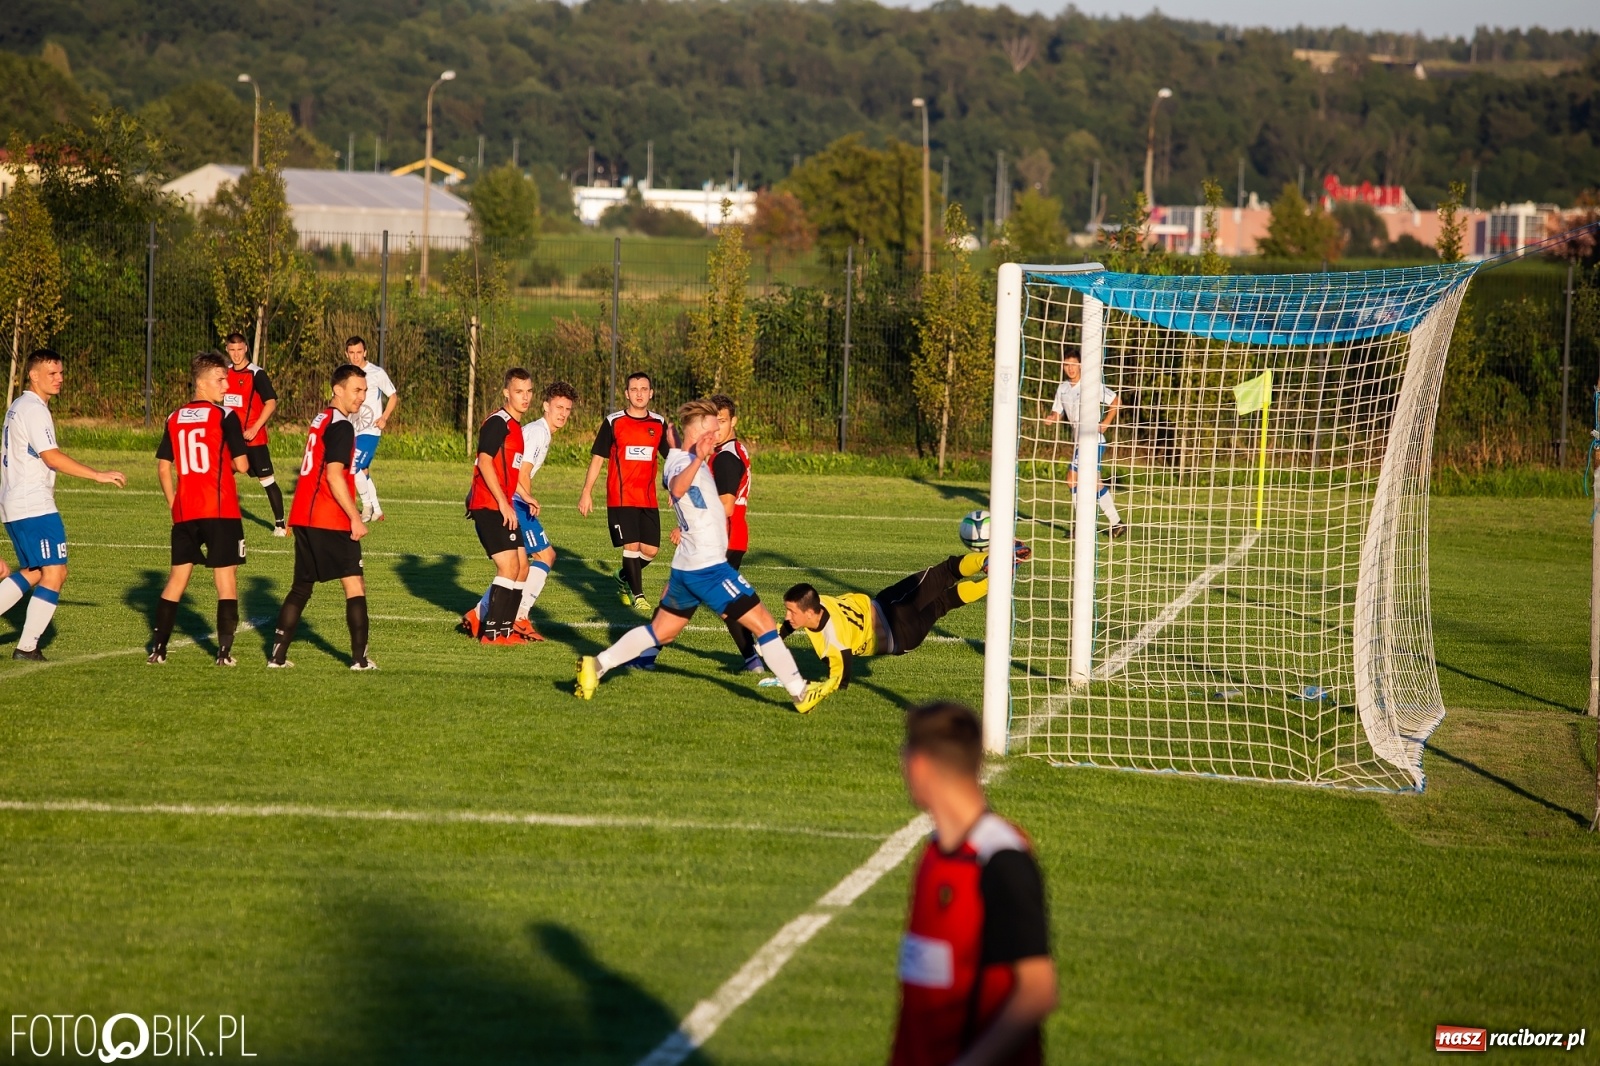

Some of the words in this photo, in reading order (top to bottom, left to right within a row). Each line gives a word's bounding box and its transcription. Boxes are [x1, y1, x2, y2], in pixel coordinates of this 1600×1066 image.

[178, 428, 210, 475] 16
[614, 524, 624, 540] 7
[57, 542, 67, 559] 19
